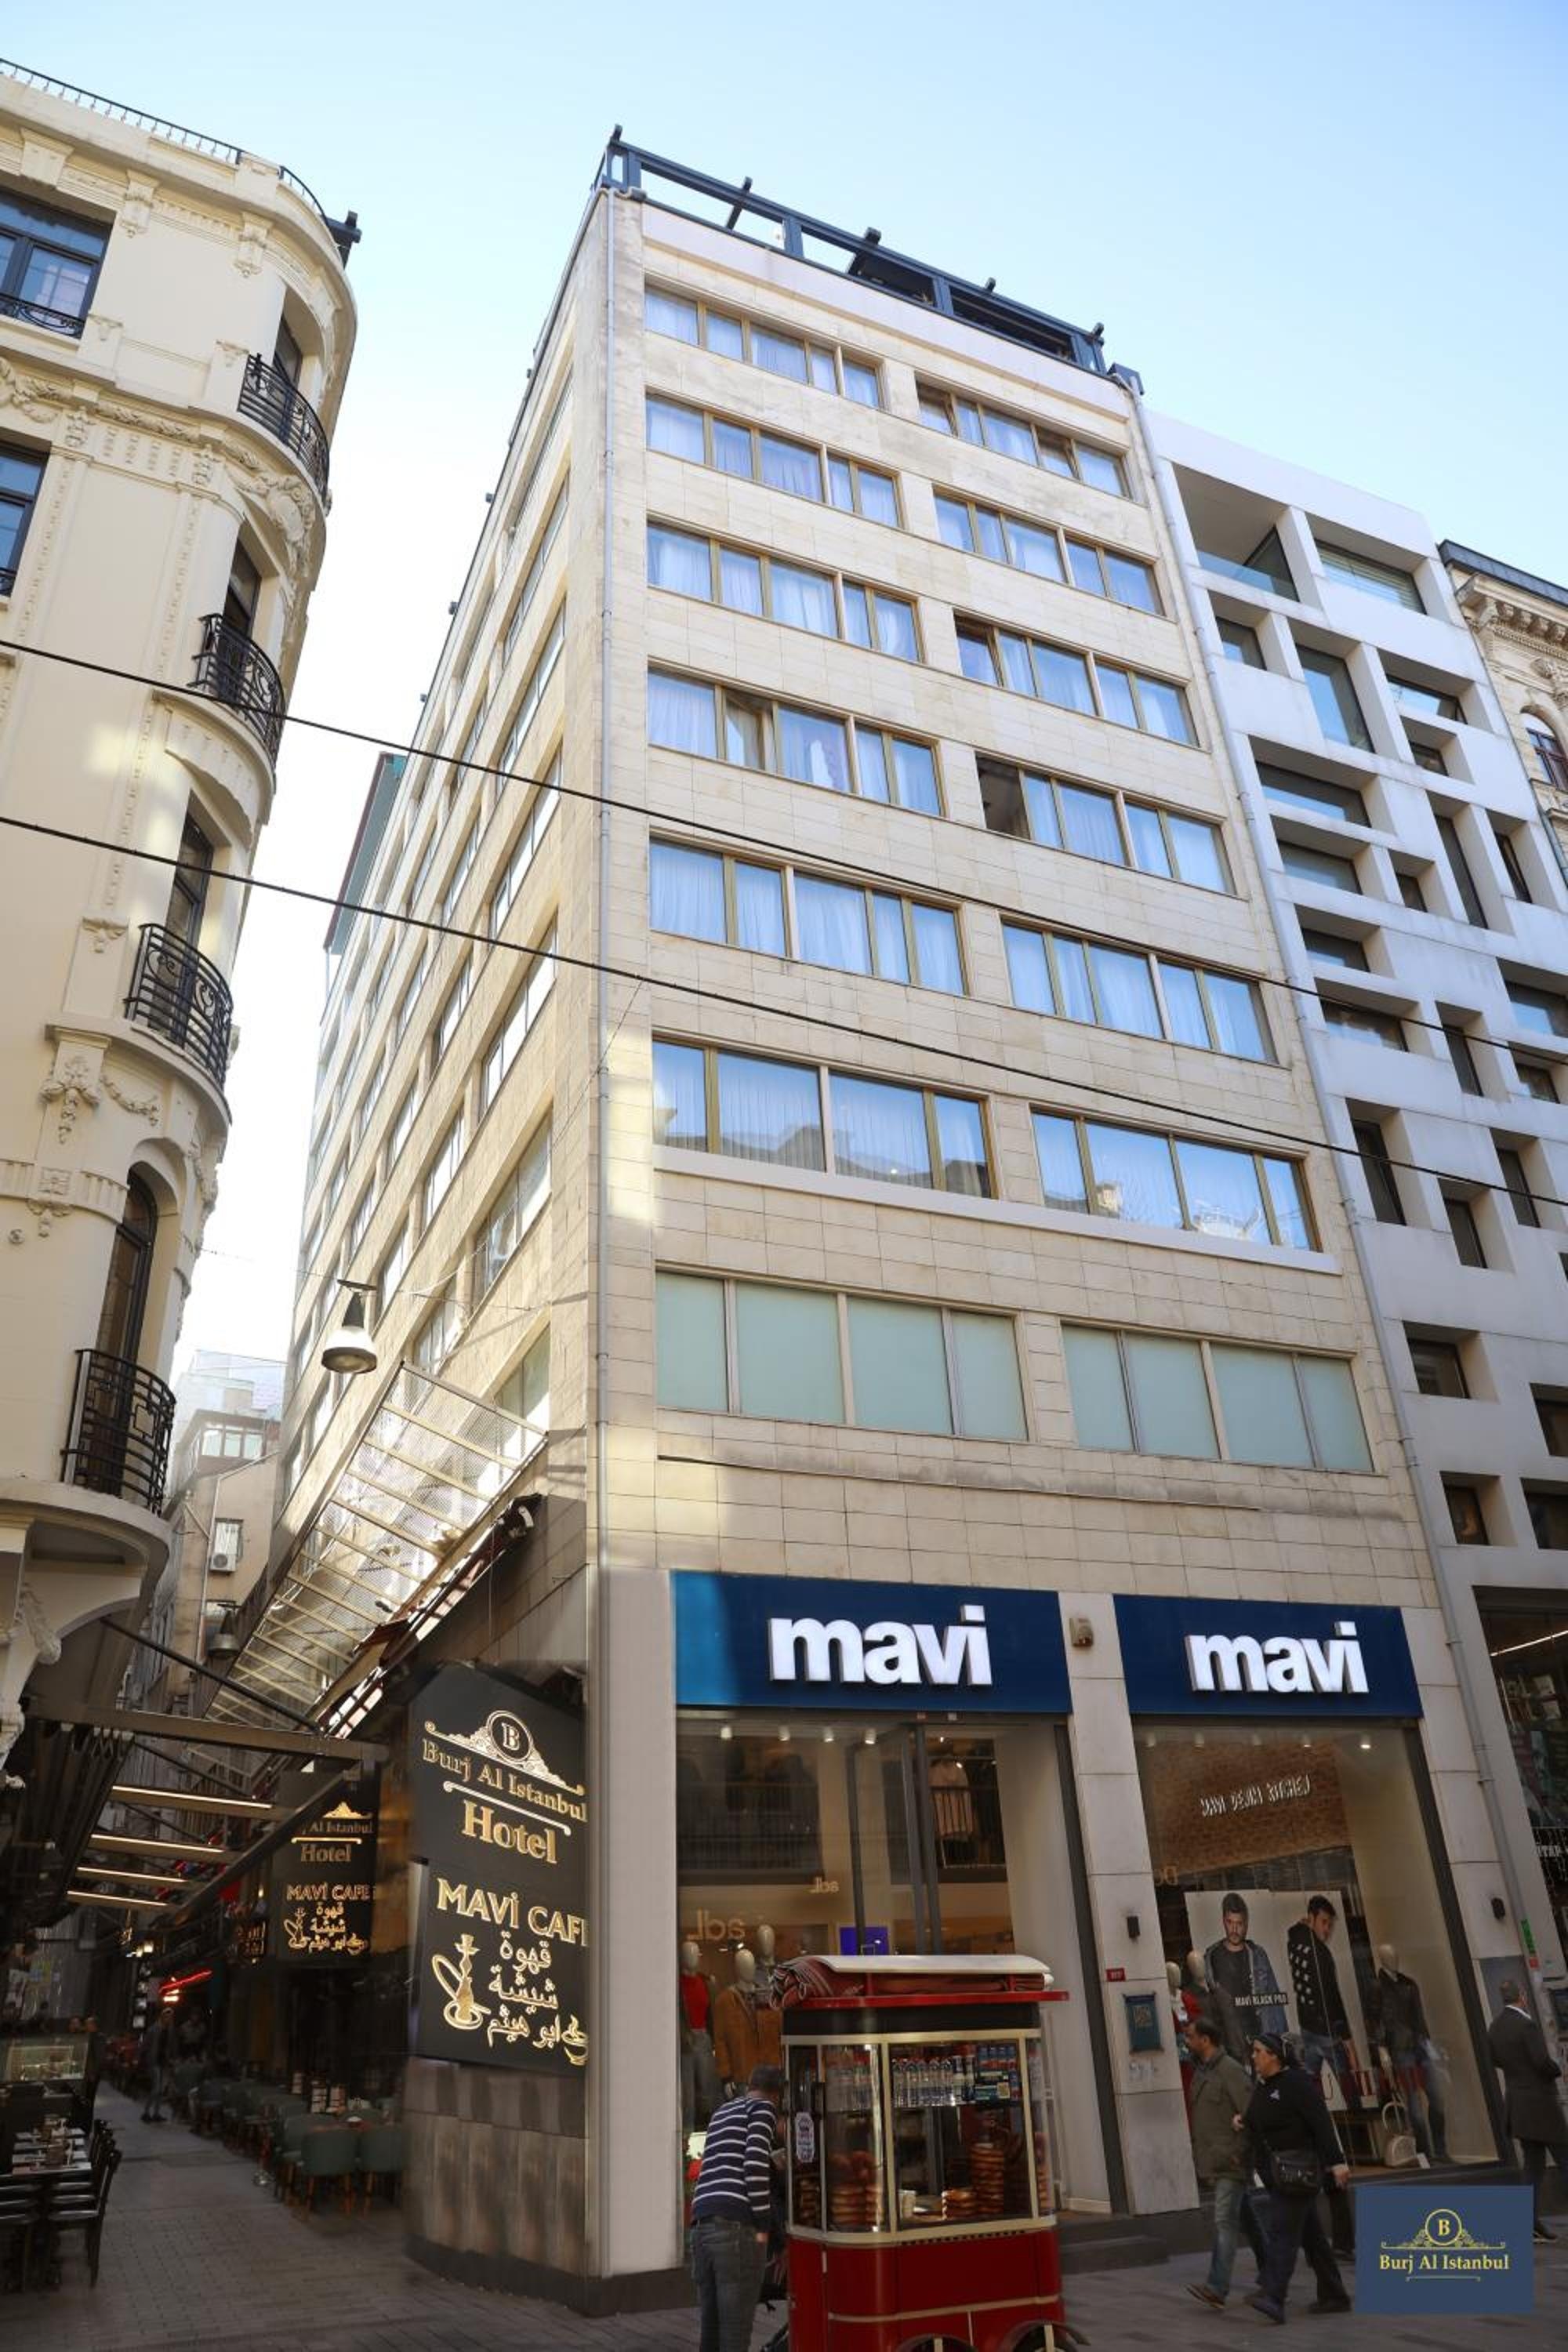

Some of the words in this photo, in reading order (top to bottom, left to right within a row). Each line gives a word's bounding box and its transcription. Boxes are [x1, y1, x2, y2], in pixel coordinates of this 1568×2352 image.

[768, 1605, 992, 1686] mavi
[1185, 1621, 1369, 1693] mavi
[502, 1722, 520, 1751] B
[423, 1739, 471, 1782] Burj
[477, 1764, 503, 1790] Al
[509, 1774, 587, 1823] Istanbul
[326, 1820, 374, 1834] Istanbul
[462, 1799, 557, 1864] Hotel
[300, 1843, 352, 1863] Hotel
[332, 1885, 370, 1900] CAFE
[499, 1930, 552, 1974] قهوة
[488, 1964, 558, 2014] شيشة
[487, 2003, 530, 2048] هيثم
[532, 2014, 561, 2049] ابو
